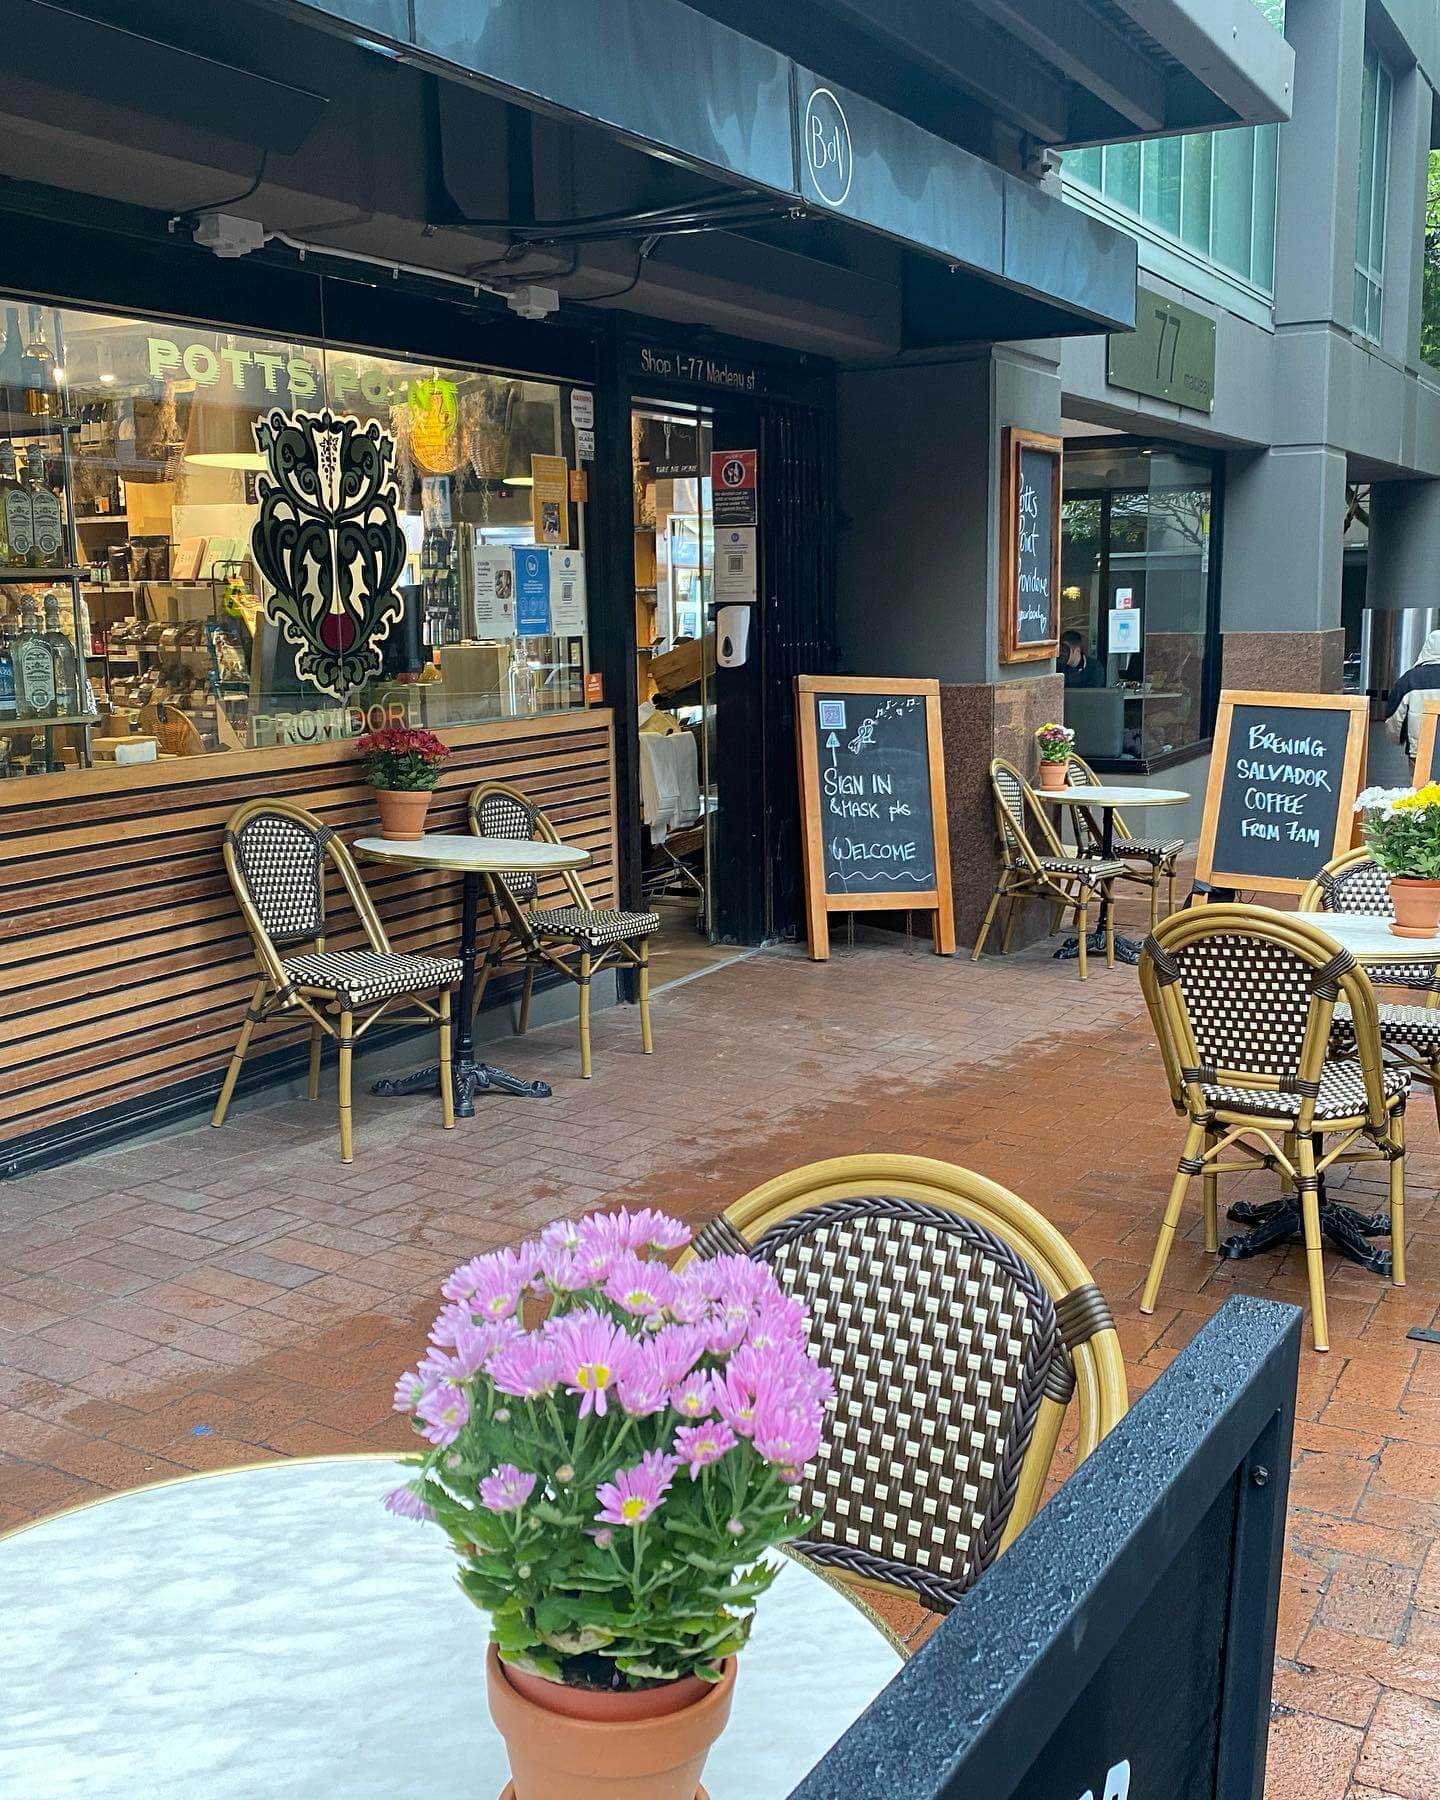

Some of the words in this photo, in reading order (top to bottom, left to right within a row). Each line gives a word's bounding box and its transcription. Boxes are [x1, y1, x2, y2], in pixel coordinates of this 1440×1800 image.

[1155, 309, 1181, 384] 77
[147, 338, 317, 399] POTTS
[641, 348, 671, 376] Shop
[676, 355, 703, 381] 1-77
[706, 361, 745, 391] Macleay
[1249, 724, 1327, 757] BREWING
[824, 767, 864, 796] SIGN
[872, 774, 892, 795] IN
[1237, 759, 1332, 793] SALVADOR
[1245, 787, 1308, 815] COFFEE
[832, 836, 916, 861] WELCOME
[1241, 818, 1280, 842] FROM
[1285, 821, 1320, 848] 7AM
